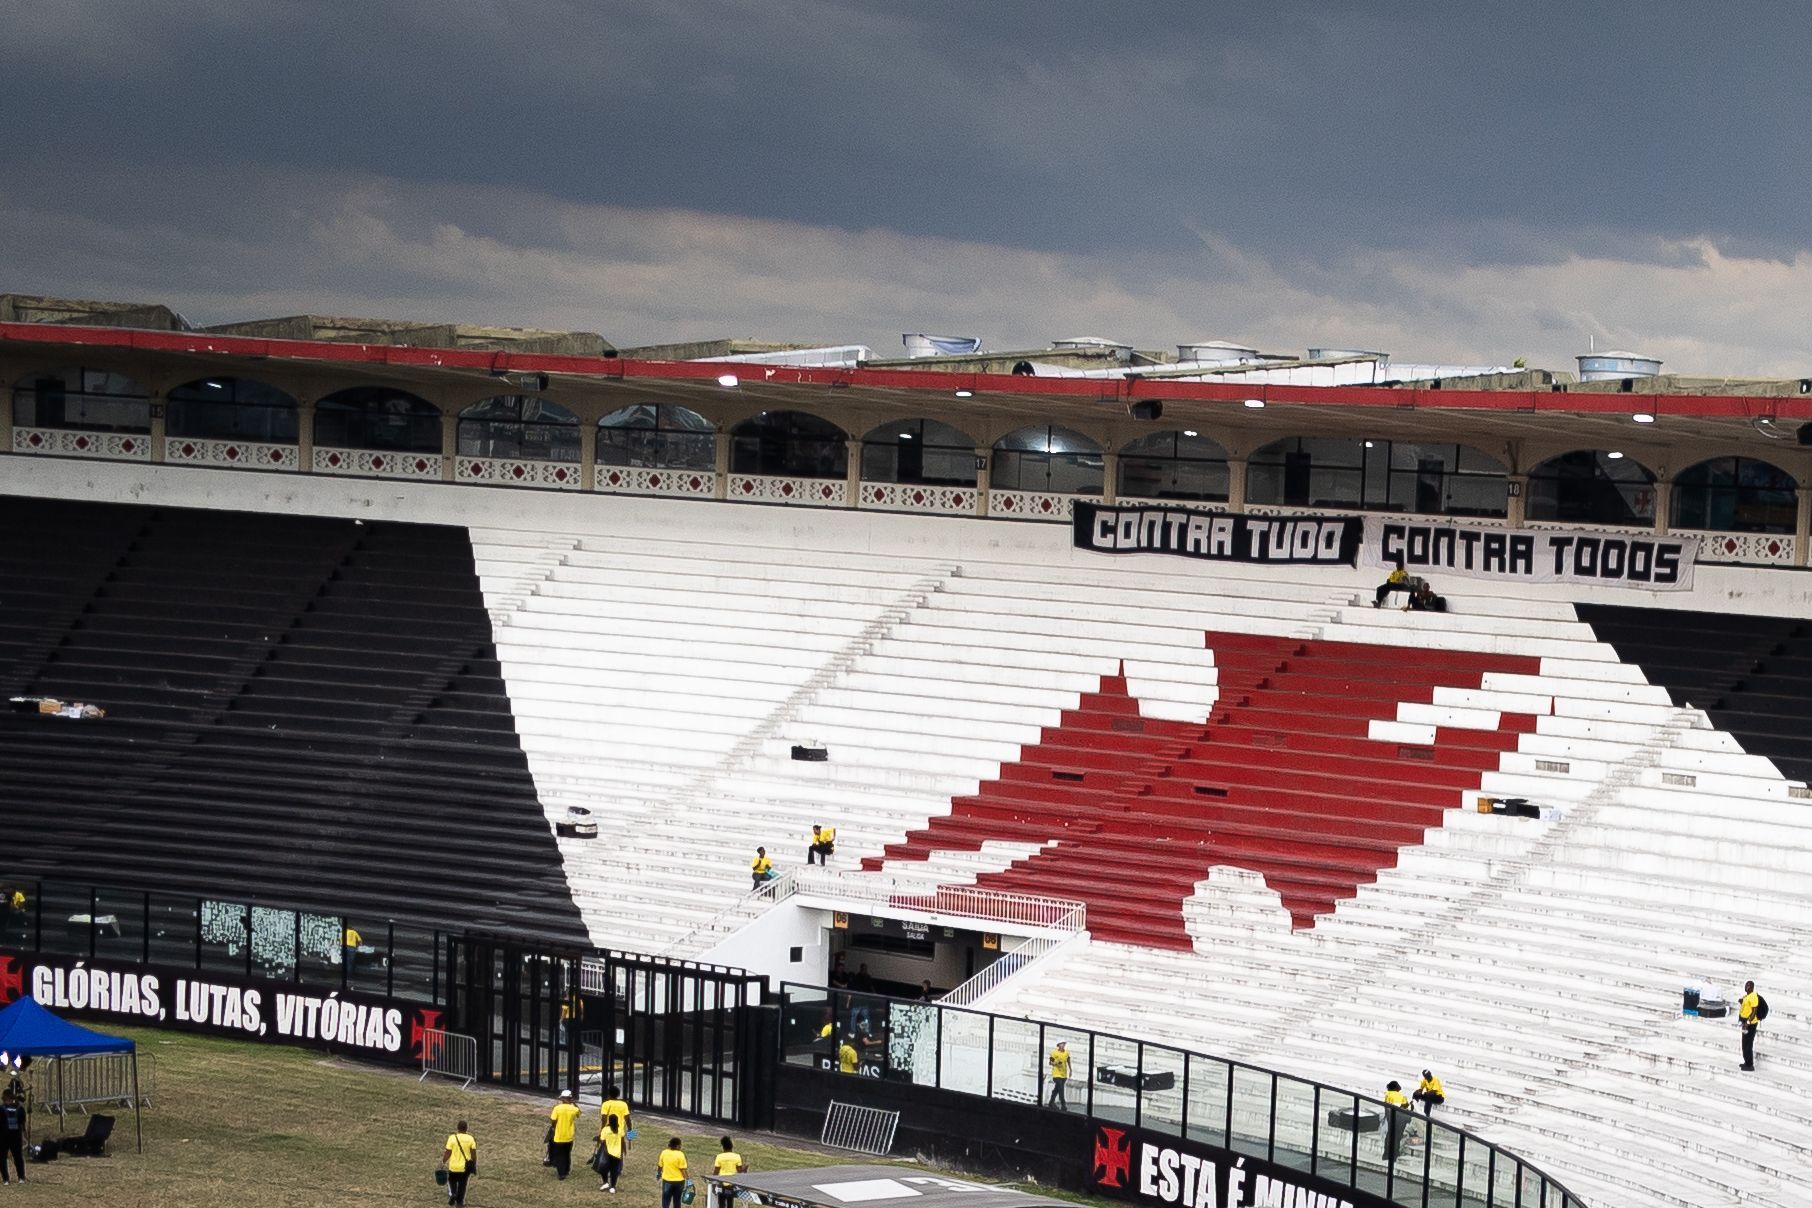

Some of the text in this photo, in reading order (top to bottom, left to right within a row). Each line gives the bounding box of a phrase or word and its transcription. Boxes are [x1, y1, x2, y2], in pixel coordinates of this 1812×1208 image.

[975, 457, 986, 469] 17
[1508, 483, 1520, 496] 18
[1092, 510, 1345, 560] CONTRA TUDO
[1381, 523, 1683, 583] CONTRA TODOS
[32, 961, 402, 1052] GLÓRIAS, LUTAS, VITÓRIAS
